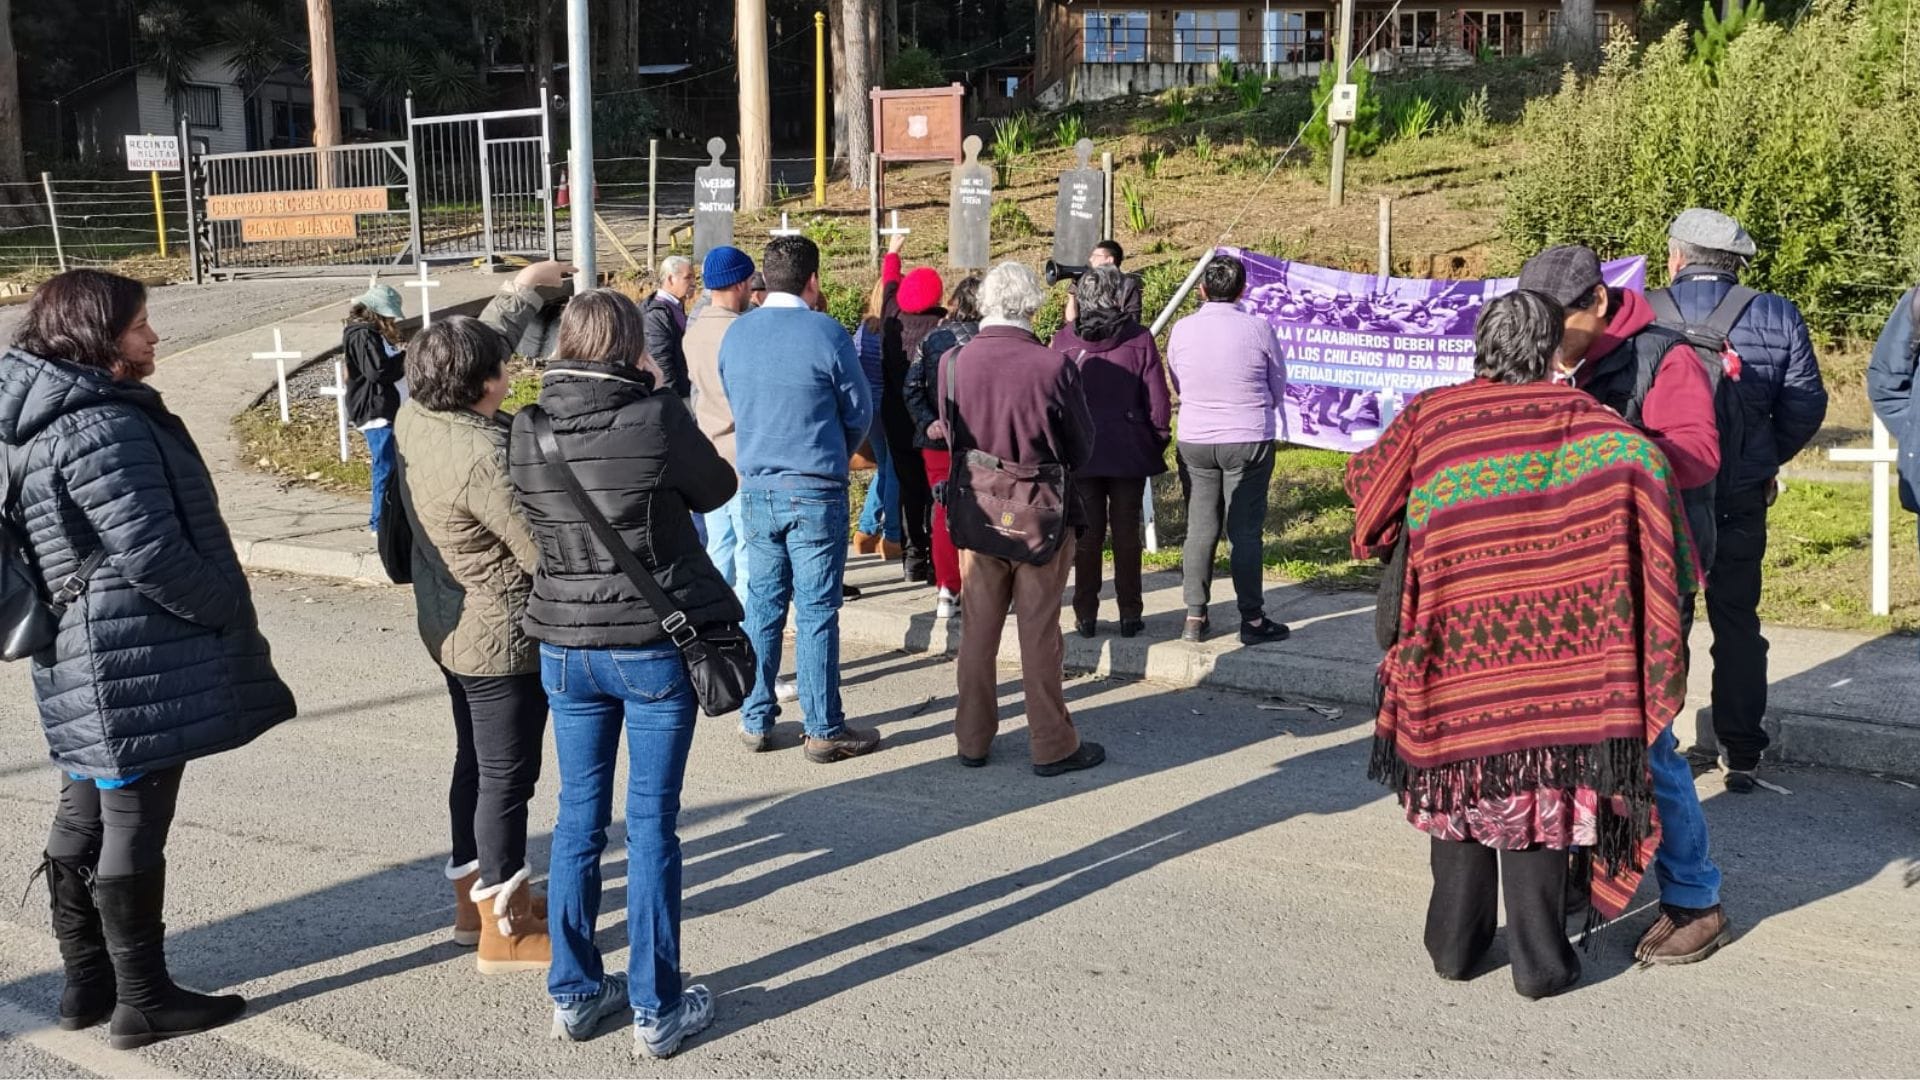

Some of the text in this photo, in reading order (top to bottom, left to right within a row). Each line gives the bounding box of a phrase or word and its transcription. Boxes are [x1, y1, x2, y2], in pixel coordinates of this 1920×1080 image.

[129, 140, 175, 149] RECINTO
[137, 150, 178, 158] MILITAR
[130, 159, 179, 168] NO ENTRAR
[212, 193, 382, 216] CENTRO RECREACIONAL
[247, 218, 351, 237] PLAYA BLANCA
[1276, 326, 1292, 340] AA
[1296, 327, 1304, 342] Y
[1306, 328, 1390, 349] CARABINEROS
[1393, 336, 1434, 351] DEBEN
[1286, 345, 1295, 359] A
[1298, 346, 1320, 362] LOS
[1324, 348, 1384, 367] CHILENOS
[1387, 352, 1405, 368] NO
[1408, 354, 1433, 370] ERA
[1437, 355, 1455, 371] SU
